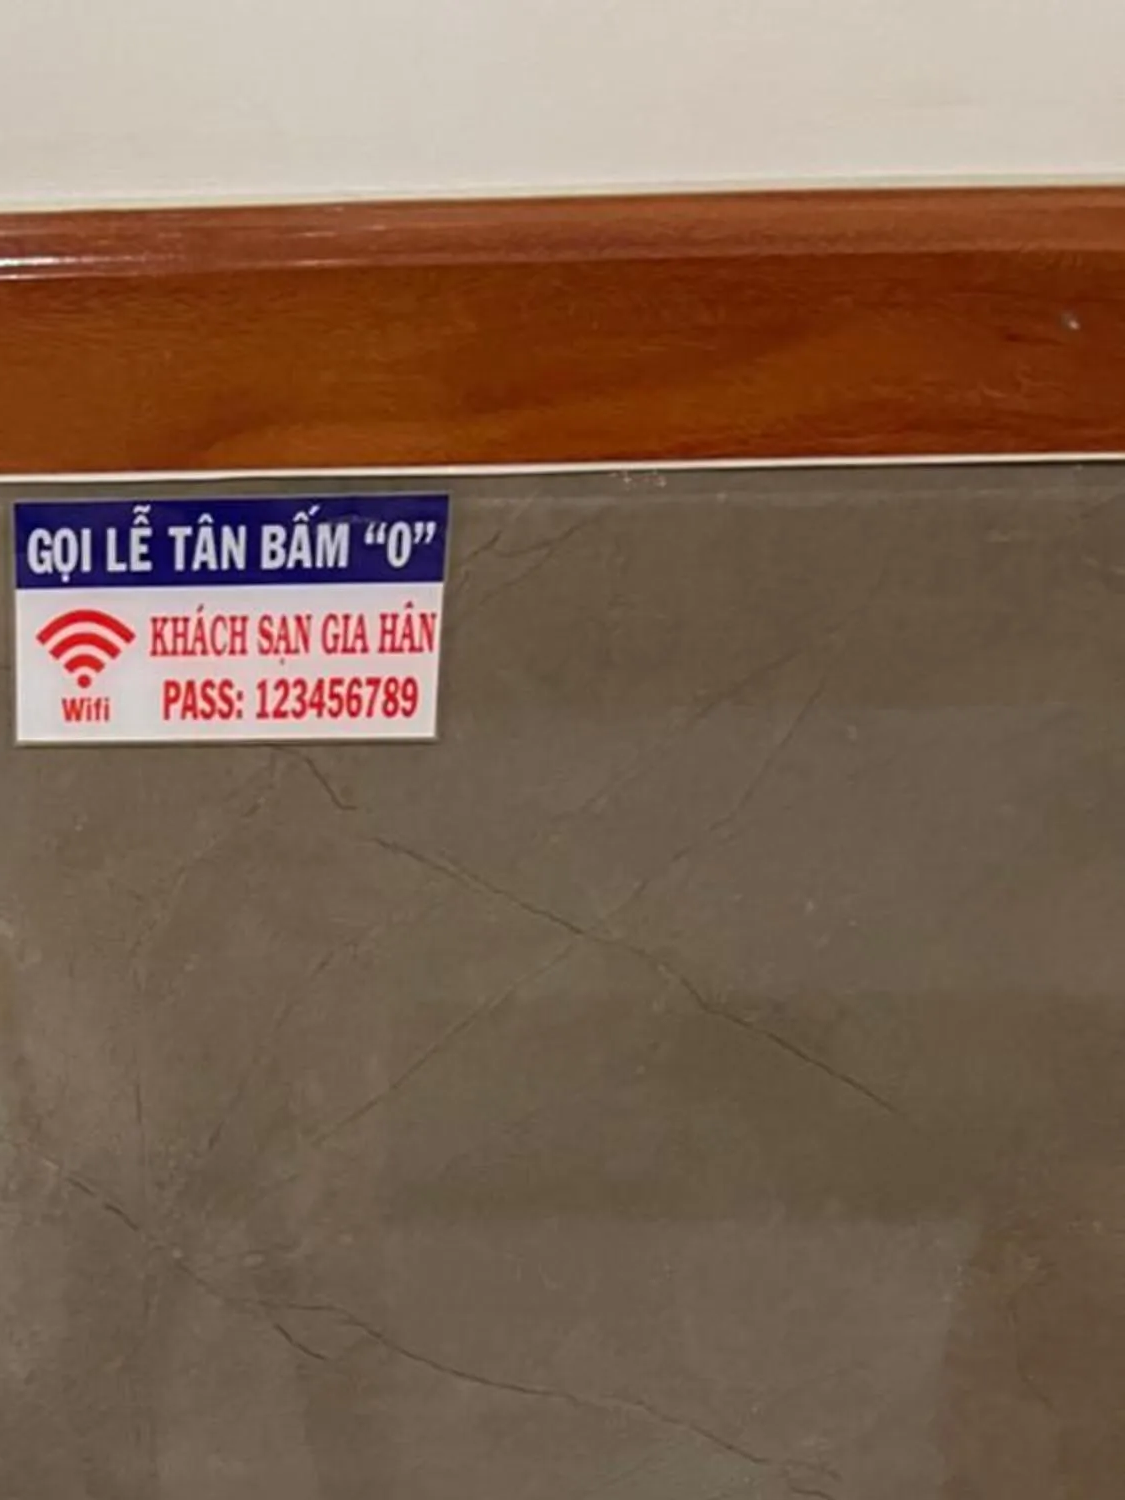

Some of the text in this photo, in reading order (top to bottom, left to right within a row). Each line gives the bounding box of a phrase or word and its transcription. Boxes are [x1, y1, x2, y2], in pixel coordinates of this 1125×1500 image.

[27, 527, 92, 583] GỌI
[106, 504, 153, 572] LỄ
[168, 512, 248, 571] TÂN
[261, 504, 350, 570] BẤM
[150, 600, 437, 666] KHÁCH SẠN GIA HÂN
[61, 697, 111, 722] Wifi
[163, 677, 418, 720] PASS: 123456789
